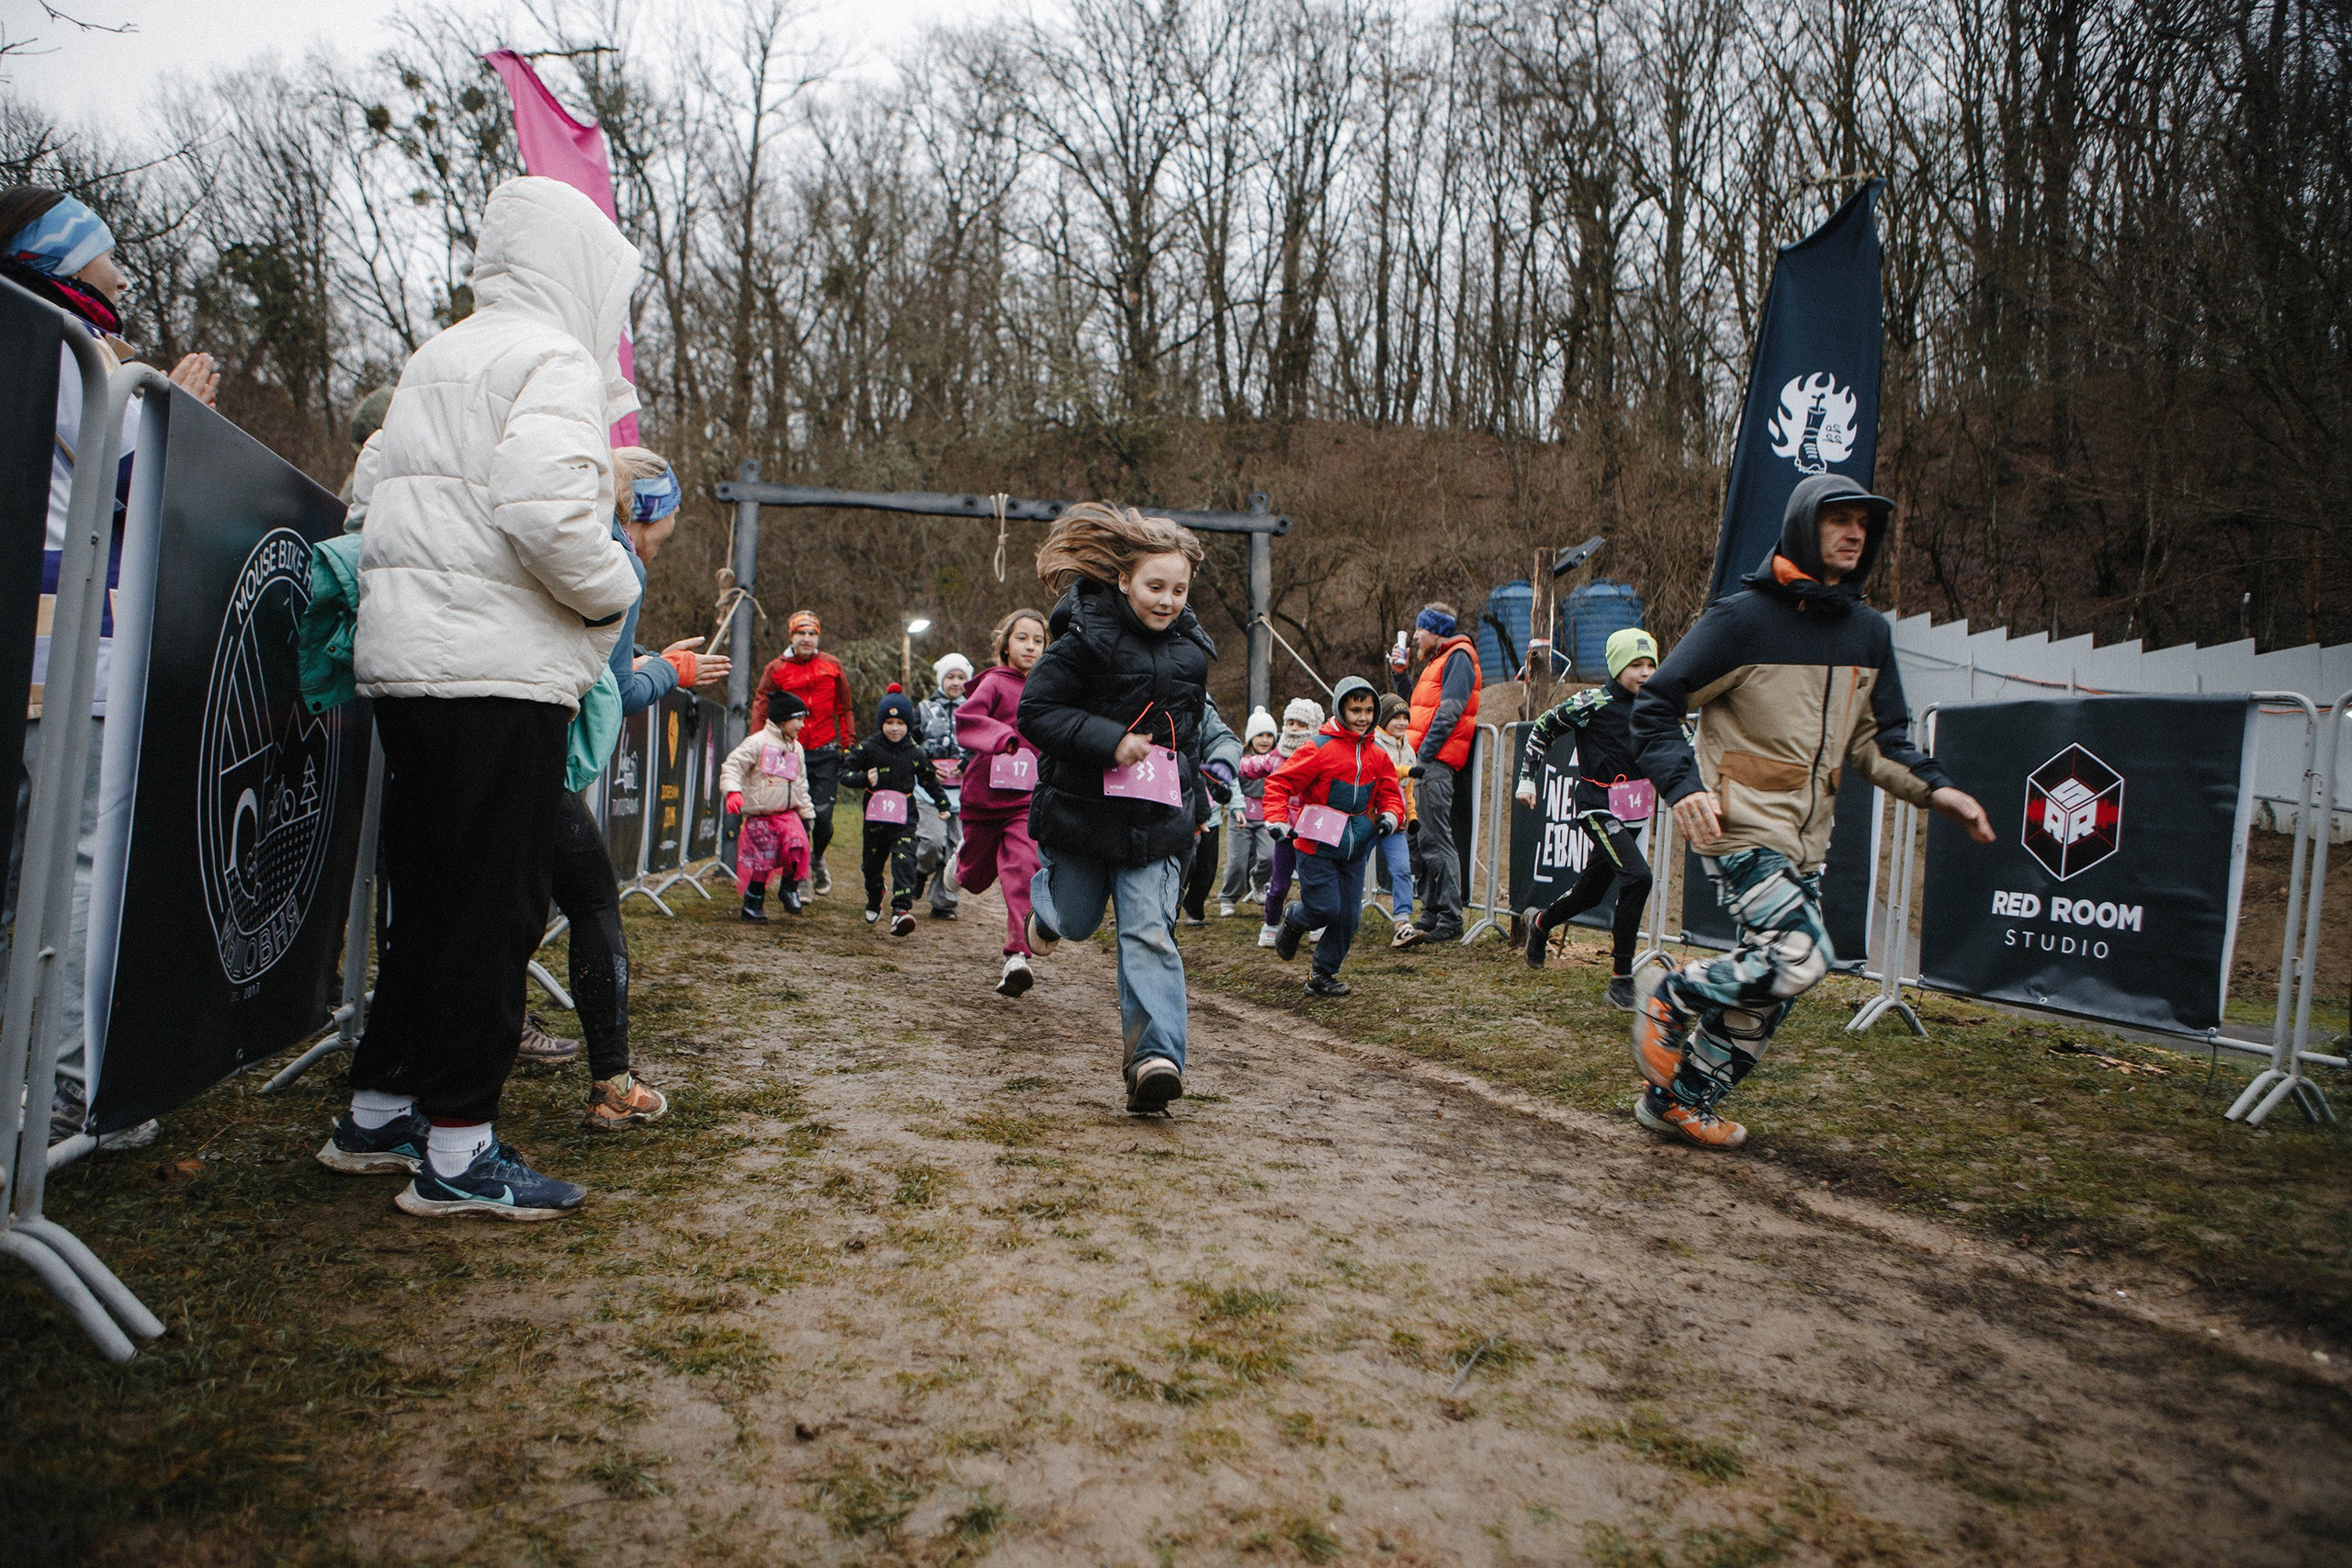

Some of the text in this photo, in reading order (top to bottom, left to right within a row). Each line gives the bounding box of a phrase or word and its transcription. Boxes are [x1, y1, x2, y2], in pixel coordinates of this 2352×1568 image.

[235, 541, 277, 625] MOUSE
[278, 539, 305, 580] BIKE
[1012, 761, 1028, 777] 17
[1136, 760, 1156, 782] 33
[882, 799, 896, 813] 19
[1627, 792, 1642, 808] 14
[1314, 816, 1324, 829] 4
[1991, 890, 2143, 932] RED ROOM
[2004, 929, 2109, 960] STUDIO
